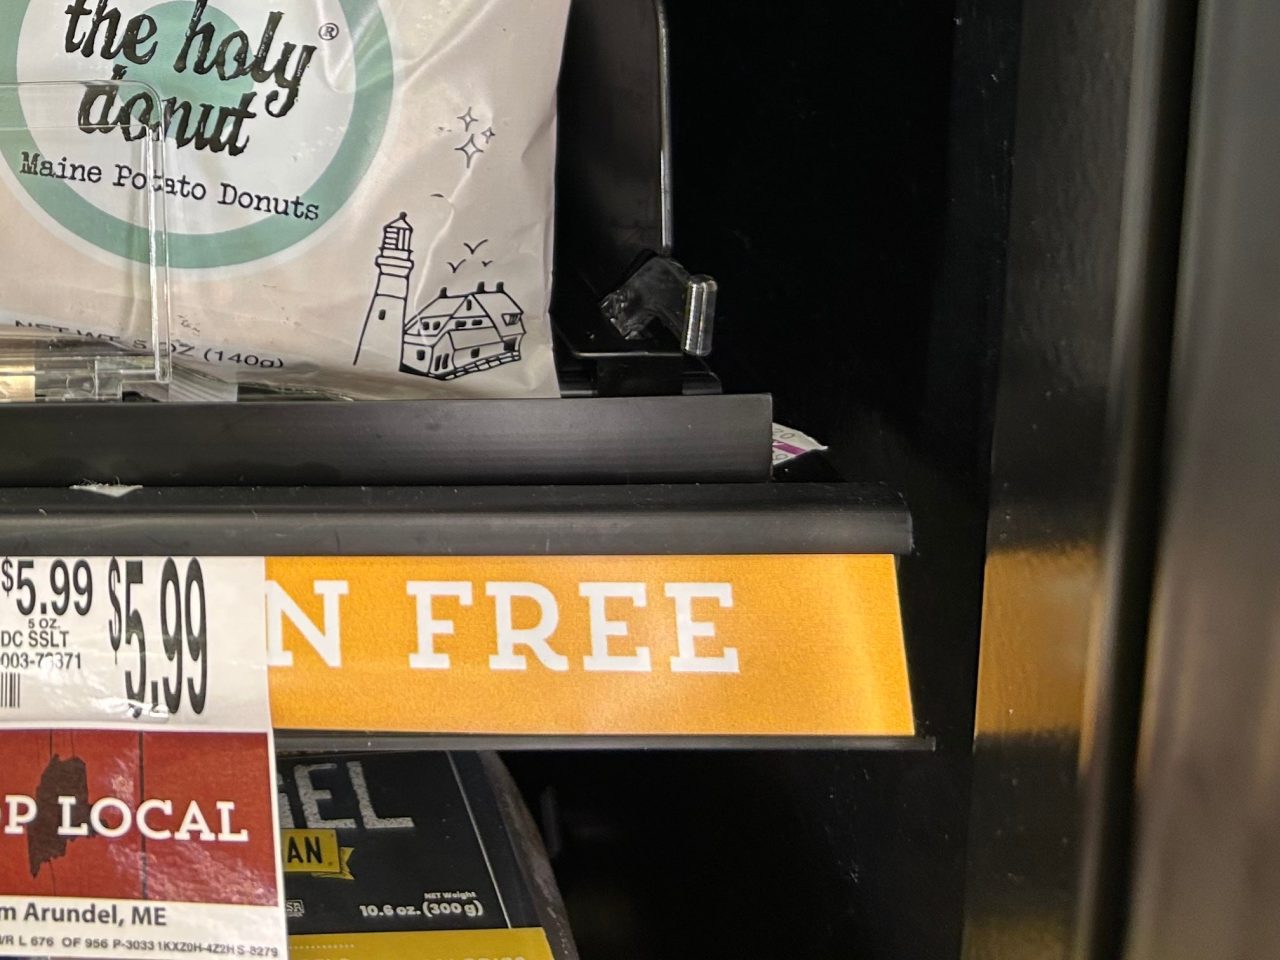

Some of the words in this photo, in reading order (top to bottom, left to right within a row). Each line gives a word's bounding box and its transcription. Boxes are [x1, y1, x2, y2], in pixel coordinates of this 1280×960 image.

[78, 64, 258, 157] donut
[19, 151, 103, 184] Maine
[113, 164, 208, 201] Potato
[217, 183, 320, 222] Donuts
[1, 556, 94, 616] $5.99
[0, 631, 24, 648] DC
[28, 631, 70, 649] SSLT
[28, 618, 36, 629] 5
[108, 555, 208, 716] $5.99
[406, 580, 740, 673] FREE
[57, 796, 250, 843] LOCAL
[23, 902, 125, 928] Arundel,
[131, 906, 168, 927] ME
[359, 906, 395, 918] 10.6
[397, 906, 421, 917] oz.
[61, 937, 82, 948] OF
